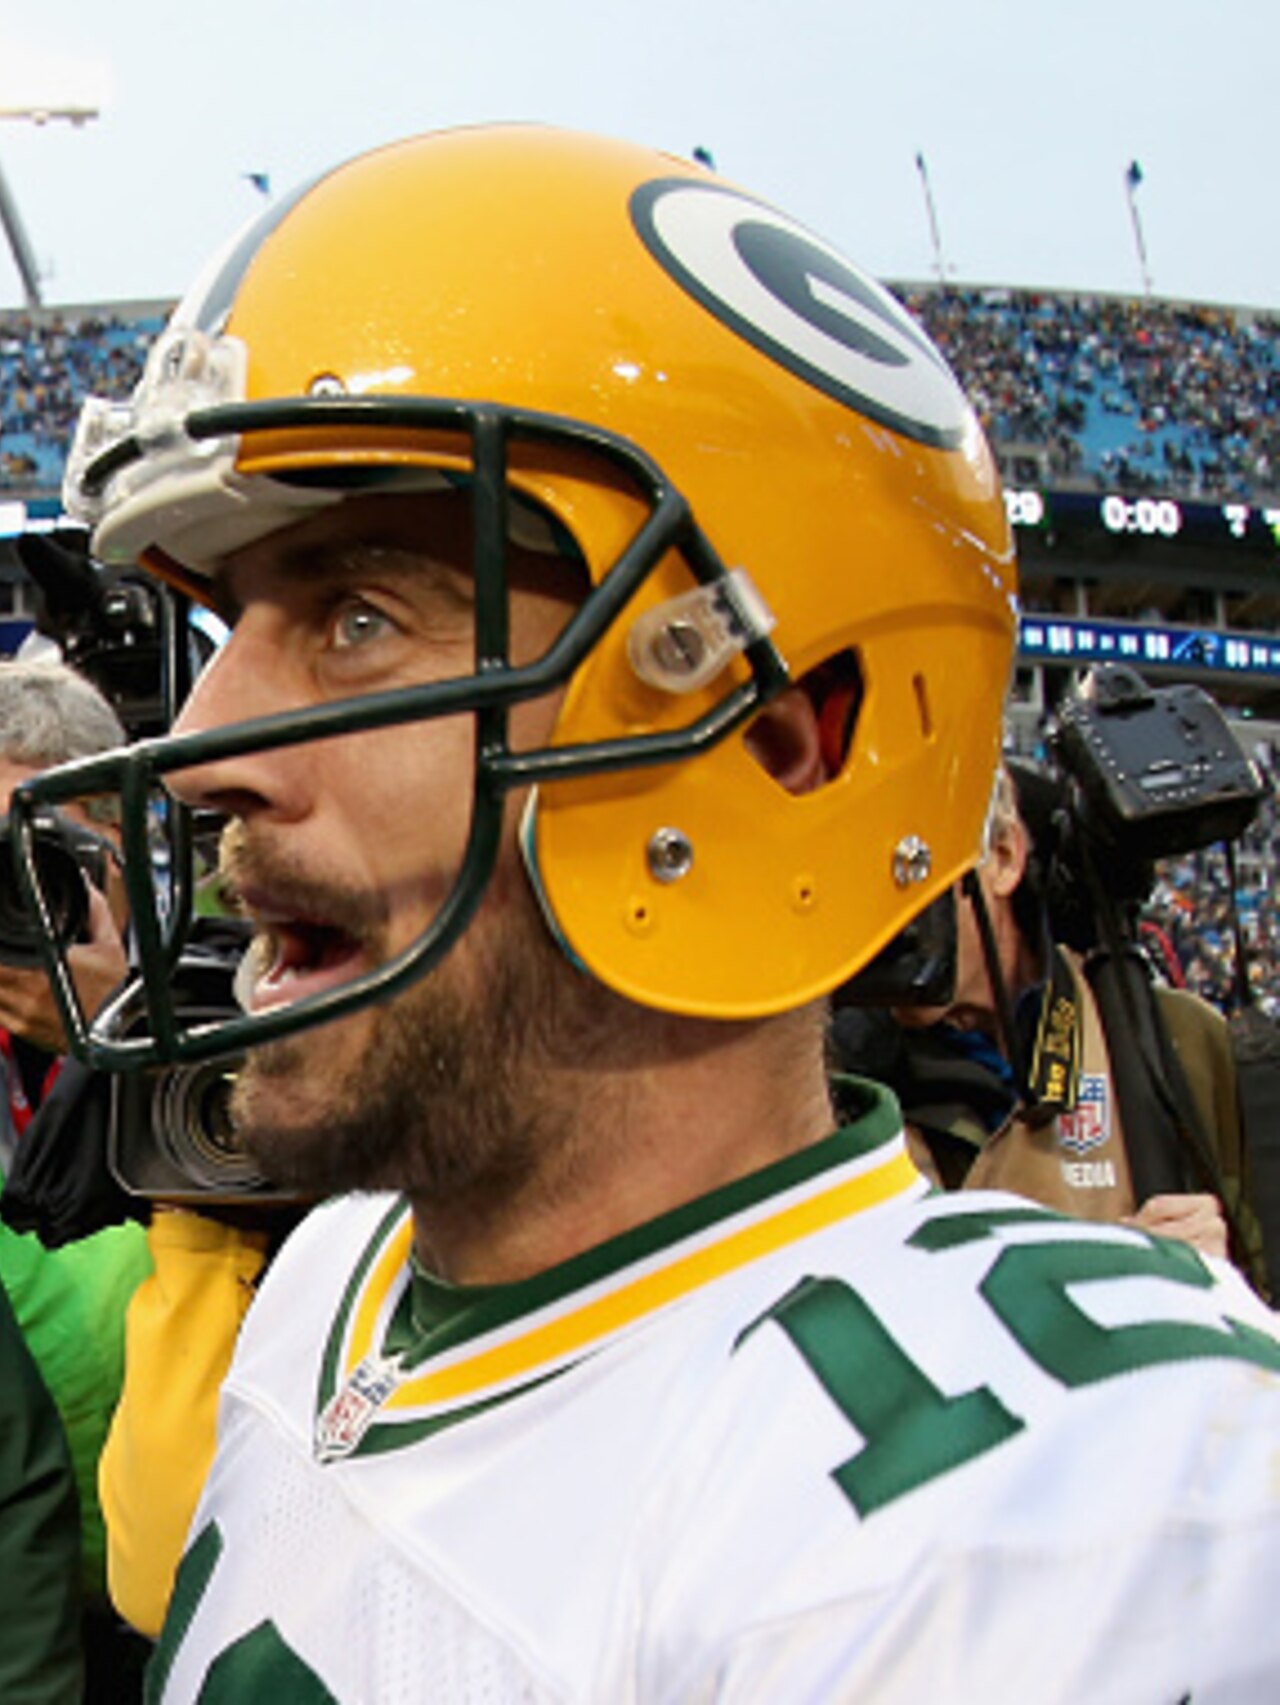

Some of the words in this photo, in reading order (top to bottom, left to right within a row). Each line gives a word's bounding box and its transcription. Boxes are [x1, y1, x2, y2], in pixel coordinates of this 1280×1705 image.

[645, 184, 965, 437] G
[1101, 496, 1183, 537] 0:00
[730, 1208, 1280, 1523] 12
